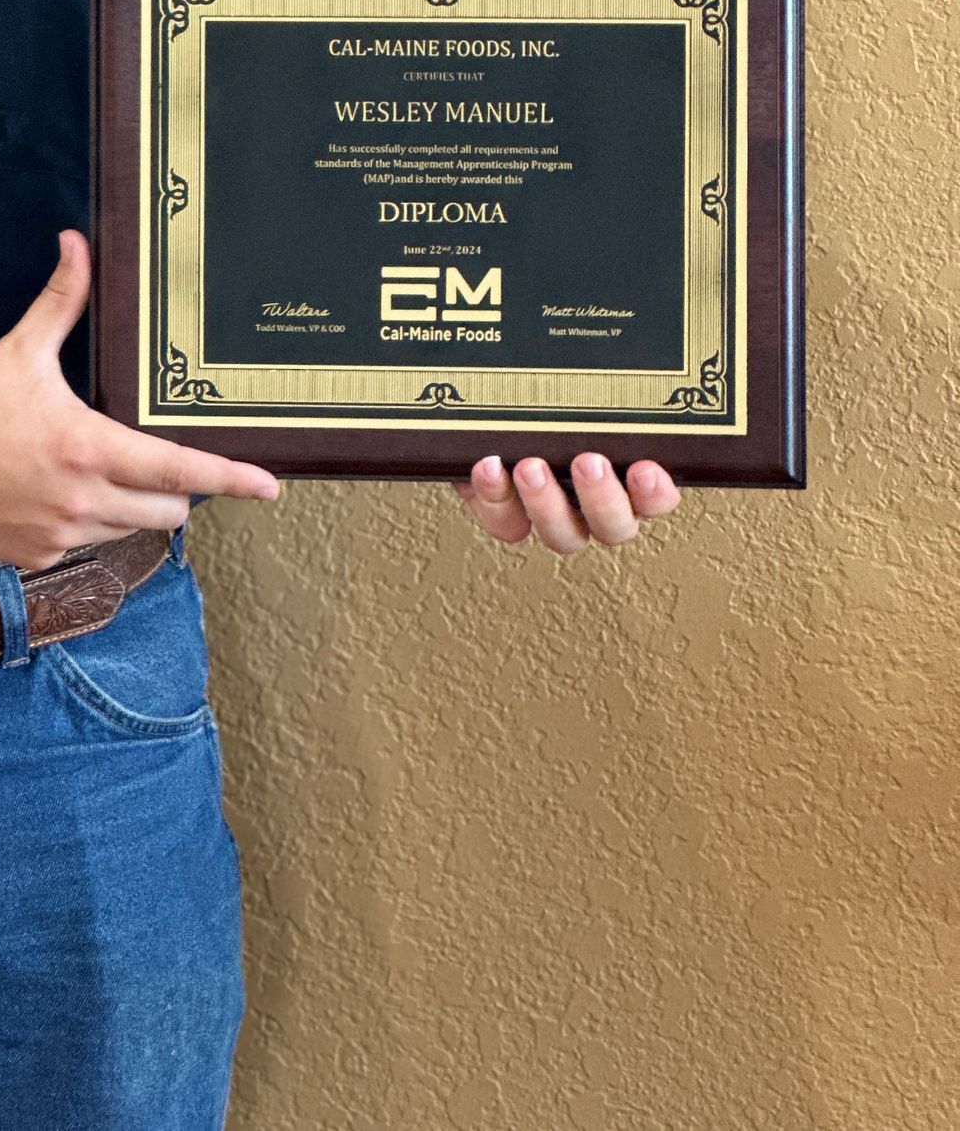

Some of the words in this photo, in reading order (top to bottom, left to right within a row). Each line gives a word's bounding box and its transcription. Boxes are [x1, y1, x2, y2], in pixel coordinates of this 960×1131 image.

[329, 39, 439, 56] CAL-MAINE
[446, 40, 515, 59] FOODS,
[522, 40, 560, 57] INC.
[403, 72, 455, 81] CERTIFIES
[457, 72, 484, 81] THAT
[335, 101, 437, 122] WESLEY
[446, 102, 553, 123] MANUEL
[329, 144, 347, 152] Has
[350, 144, 406, 156] successfully
[408, 145, 457, 155] completed
[460, 145, 471, 154] all
[474, 147, 538, 156] requirements
[541, 145, 559, 154] and
[314, 159, 361, 168] standards
[364, 159, 374, 168] of
[375, 159, 391, 168] the
[393, 159, 454, 170] Management
[457, 160, 529, 171] Apprenticeship
[531, 160, 572, 172] Program
[363, 174, 413, 185] (MAP)and
[416, 175, 423, 183] is
[426, 174, 458, 186] hereby
[461, 175, 502, 184] awarded
[505, 175, 523, 184] this
[379, 202, 507, 223] DIPLOMA
[404, 245, 427, 255] June
[456, 246, 481, 255] 2024
[542, 305, 576, 317] Matt
[255, 324, 276, 332] Todd
[277, 324, 307, 333] Walters,
[329, 325, 345, 333] COO
[380, 326, 452, 341] Cal-Maine
[457, 327, 501, 341] Foods
[568, 328, 609, 337] Whiteman,
[611, 328, 622, 336] VP
